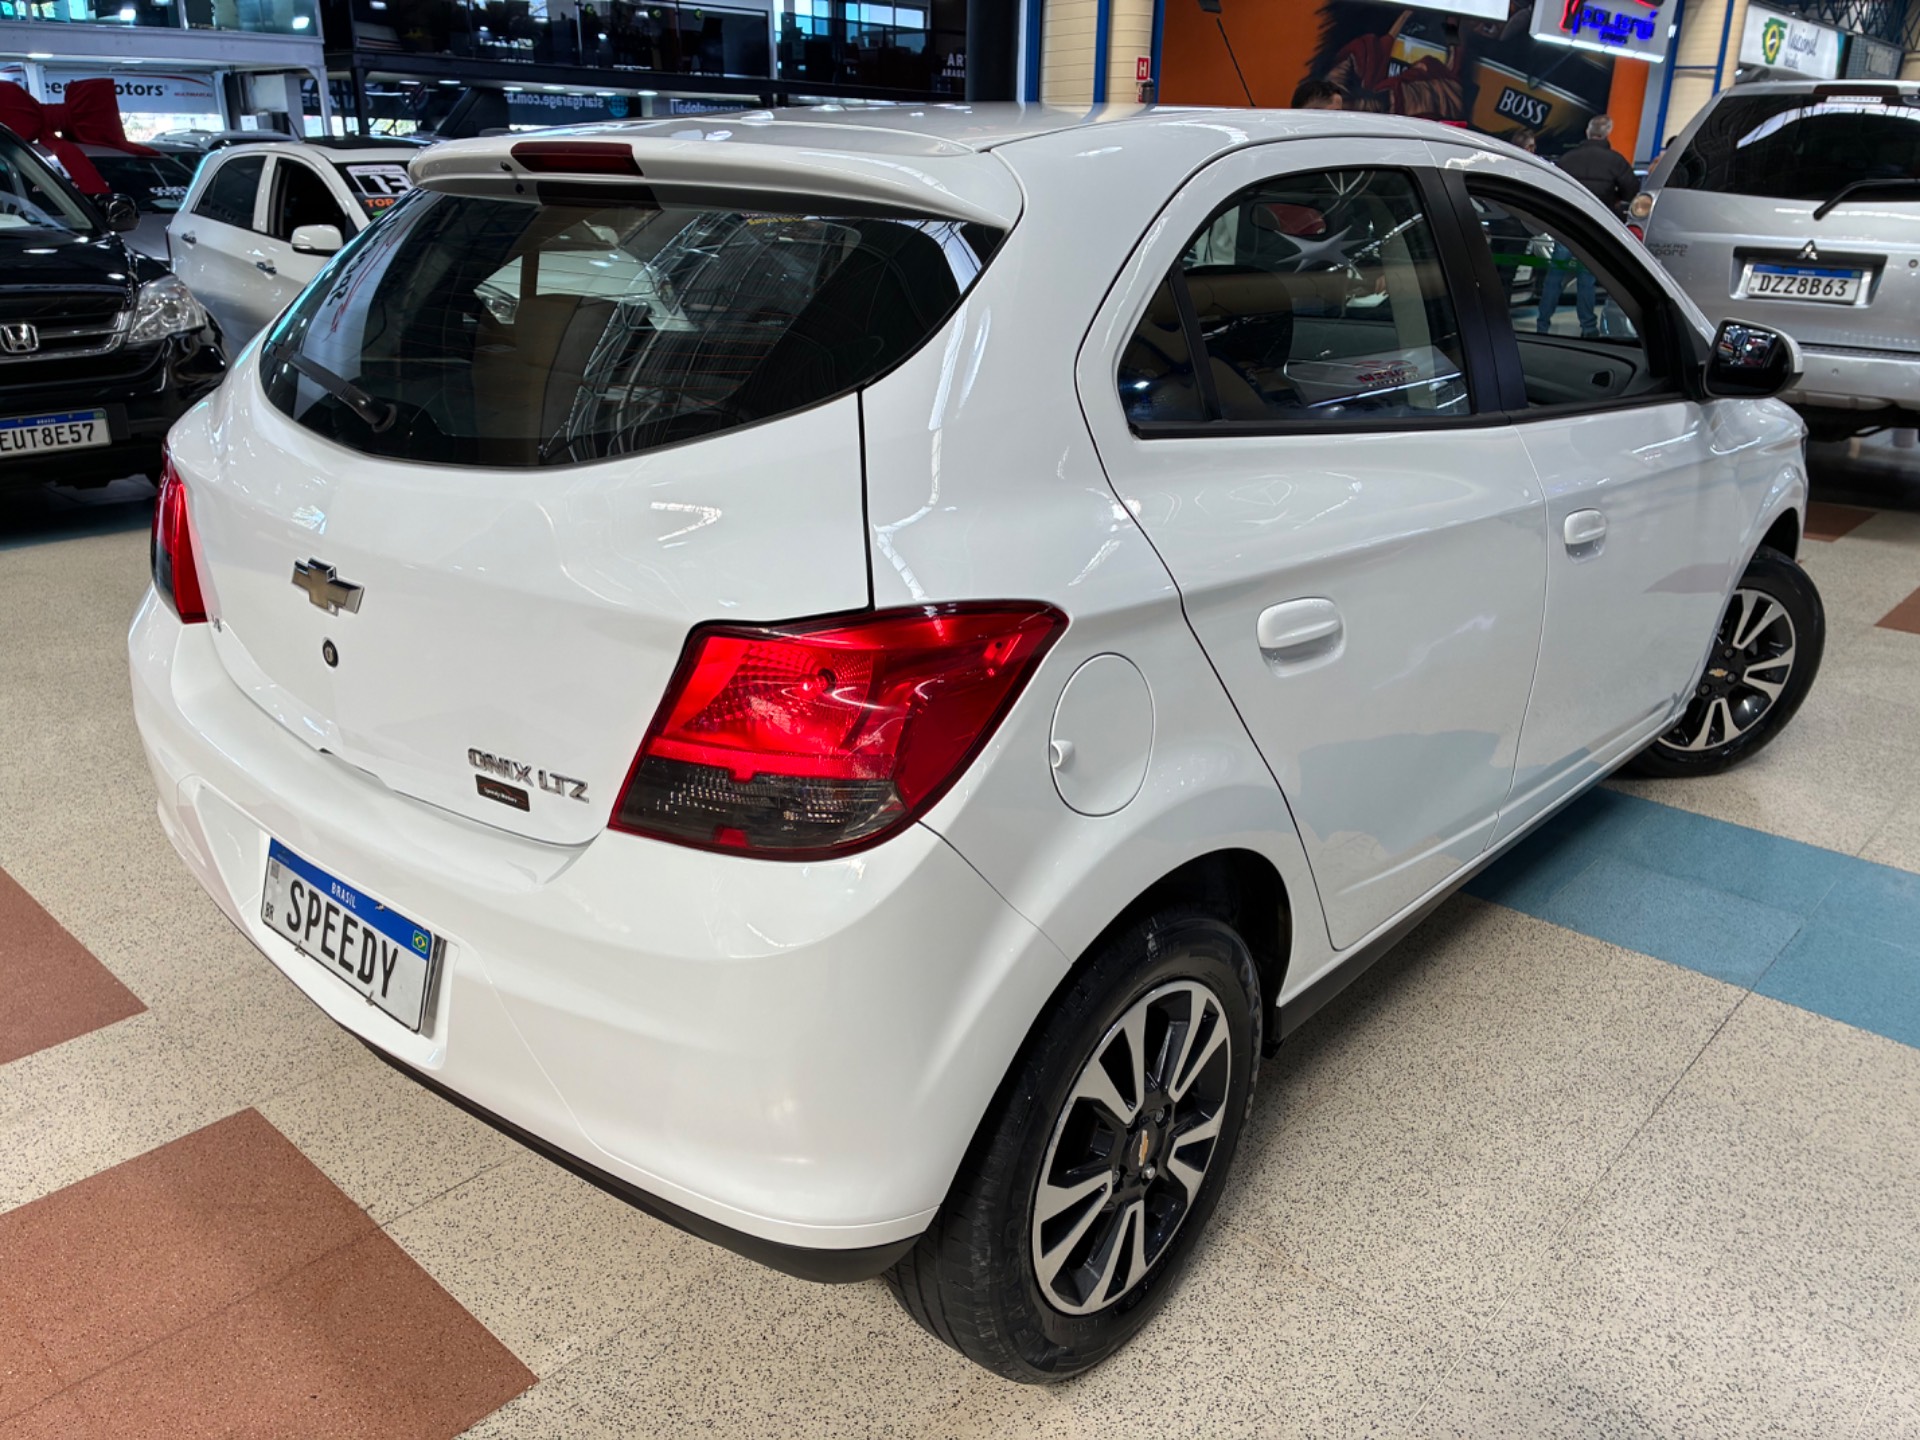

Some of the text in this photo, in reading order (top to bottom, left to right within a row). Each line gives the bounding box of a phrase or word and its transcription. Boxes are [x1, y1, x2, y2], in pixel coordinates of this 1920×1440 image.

[1139, 61, 1148, 77] H
[1499, 89, 1548, 124] BOSS
[364, 198, 395, 208] TOP
[1758, 274, 1848, 297] DZZ8B63
[0, 422, 94, 452] EUT8E57
[468, 748, 589, 804] ONIX LTZ
[331, 881, 357, 909] BRASIL
[286, 880, 399, 998] SPEEDY
